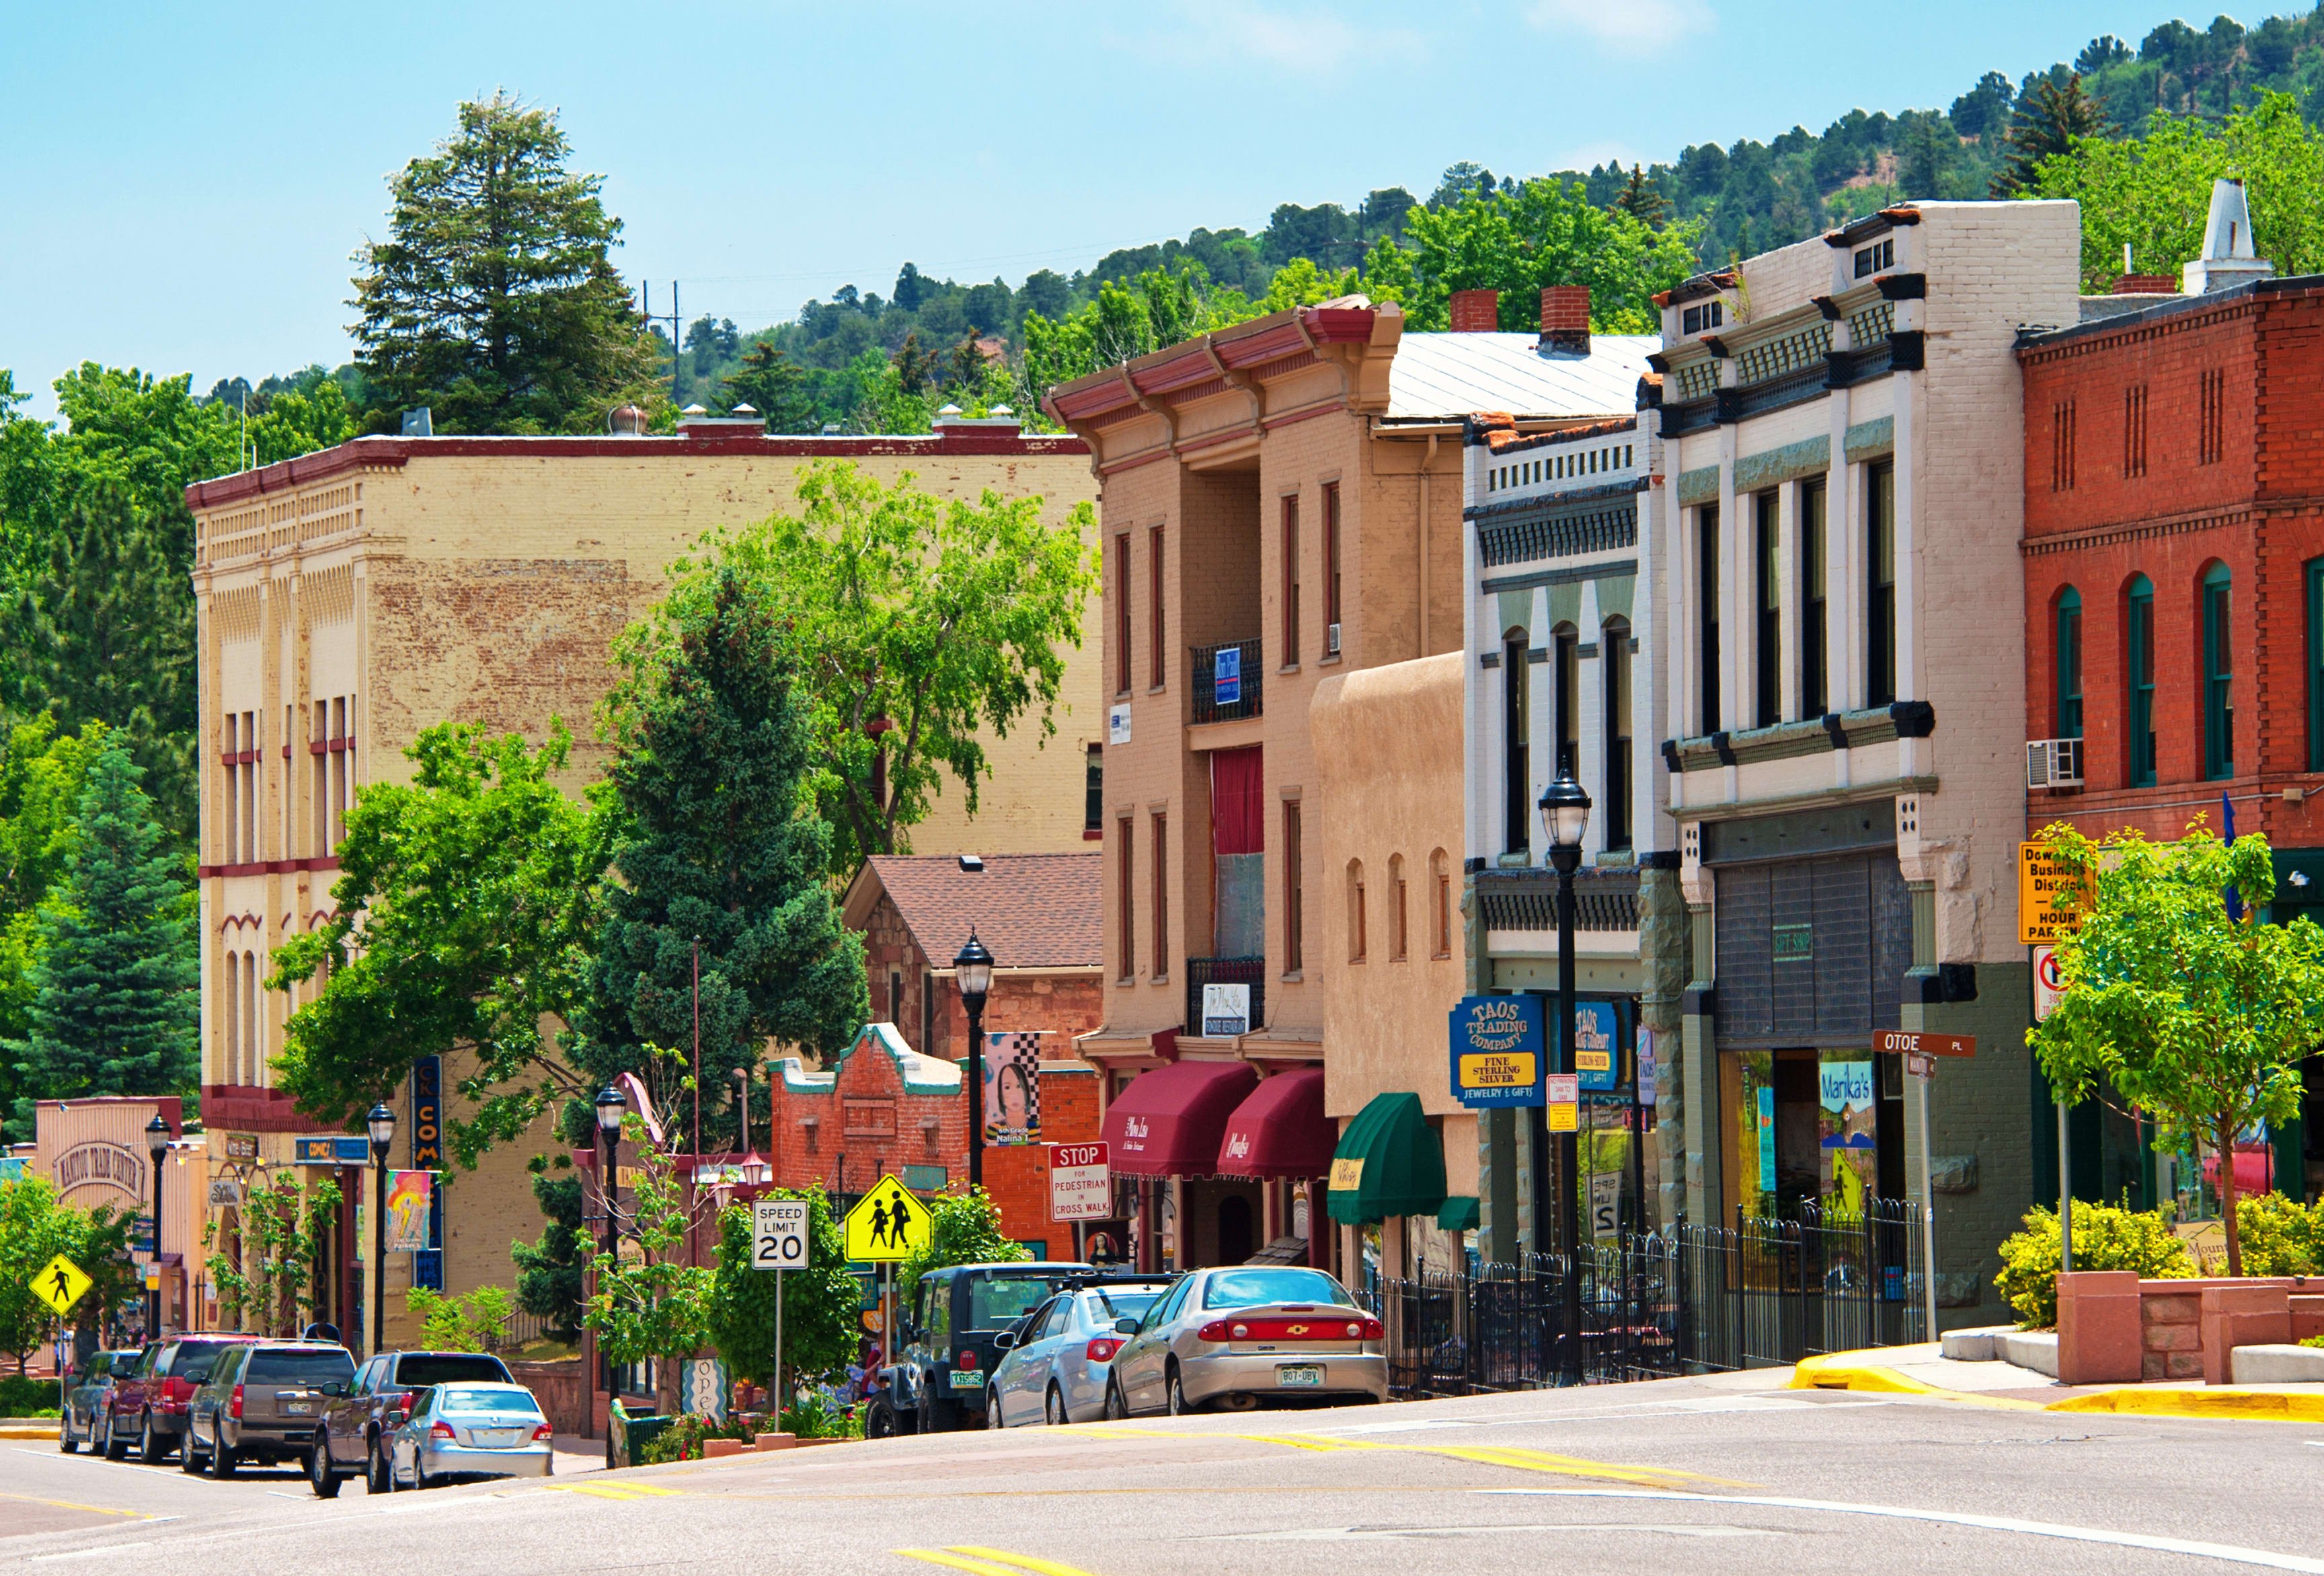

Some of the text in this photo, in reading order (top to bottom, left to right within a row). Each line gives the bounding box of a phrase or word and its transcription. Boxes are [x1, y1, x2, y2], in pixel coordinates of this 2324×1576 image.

[2040, 913, 2076, 924] HOUR
[1471, 1001, 1520, 1022] TAOS
[1466, 1020, 1528, 1035] TRADING
[1576, 1008, 1597, 1035] TAOS
[1470, 1032, 1522, 1051] COMPANY
[1885, 1033, 1963, 1051] OTOE PL
[1485, 1057, 1510, 1066] FINE
[1473, 1066, 1520, 1076] STERLING
[1639, 1060, 1654, 1078] TAOS
[1479, 1075, 1514, 1084] SILVER
[1822, 1063, 1869, 1099] Marika's
[1465, 1089, 1502, 1099] JEWELRY
[1512, 1088, 1533, 1097] GIFTS
[997, 1134, 1022, 1143] Nalina
[1060, 1147, 1099, 1166] STOP
[60, 1147, 137, 1193] MANITOU TRADE CENTER
[1055, 1179, 1106, 1191] PEDESTRIAN
[760, 1208, 802, 1219] SPEED
[1055, 1202, 1108, 1215] CROSS WALK
[765, 1222, 797, 1233] LIMIT
[759, 1236, 802, 1261] 20
